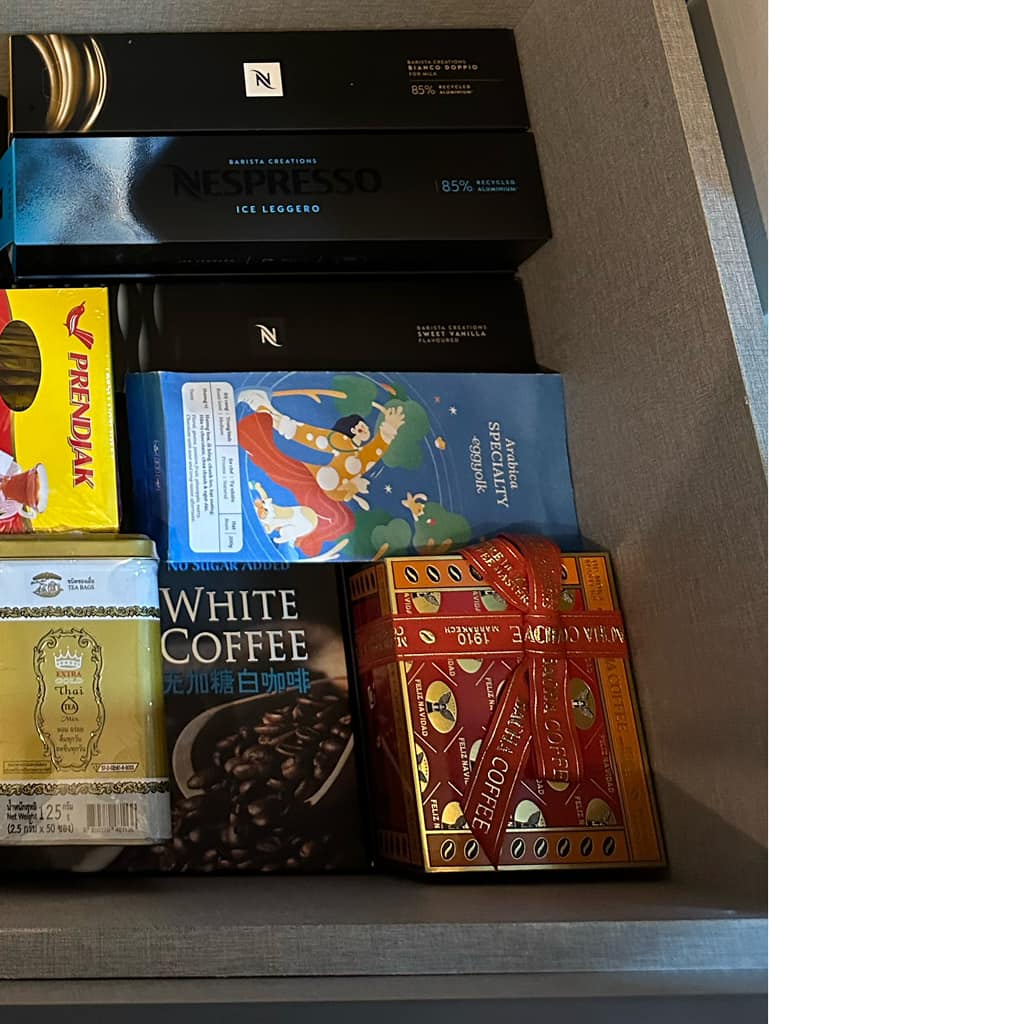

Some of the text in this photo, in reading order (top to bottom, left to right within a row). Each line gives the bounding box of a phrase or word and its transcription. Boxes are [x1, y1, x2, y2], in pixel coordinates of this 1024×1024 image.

[411, 84, 436, 95] 85%
[268, 157, 318, 165] CREATIONS
[165, 164, 384, 199] NESPRESSO
[441, 179, 474, 193] 85%
[236, 204, 321, 214] ICE LEGGERO
[67, 352, 94, 489] PRENDJAK
[469, 435, 487, 494] eggyolk
[488, 421, 509, 508] SPECIALTY
[505, 438, 519, 489] Arabica
[159, 587, 299, 623] WHITE
[444, 625, 500, 635] MARRAKECH
[457, 630, 490, 645] 1910
[160, 628, 309, 664] COFFEE
[54, 685, 84, 696] Thai
[485, 677, 493, 697] FELIZ
[64, 703, 76, 711] TEA
[414, 678, 428, 737] FELIZ NAVIDAD
[457, 737, 466, 760] FELIZ
[470, 756, 509, 836] COFFEE
[39, 803, 62, 821] 125
[430, 799, 439, 820] FELIZ
[7, 824, 22, 834] (2.5
[46, 824, 55, 833] 50
